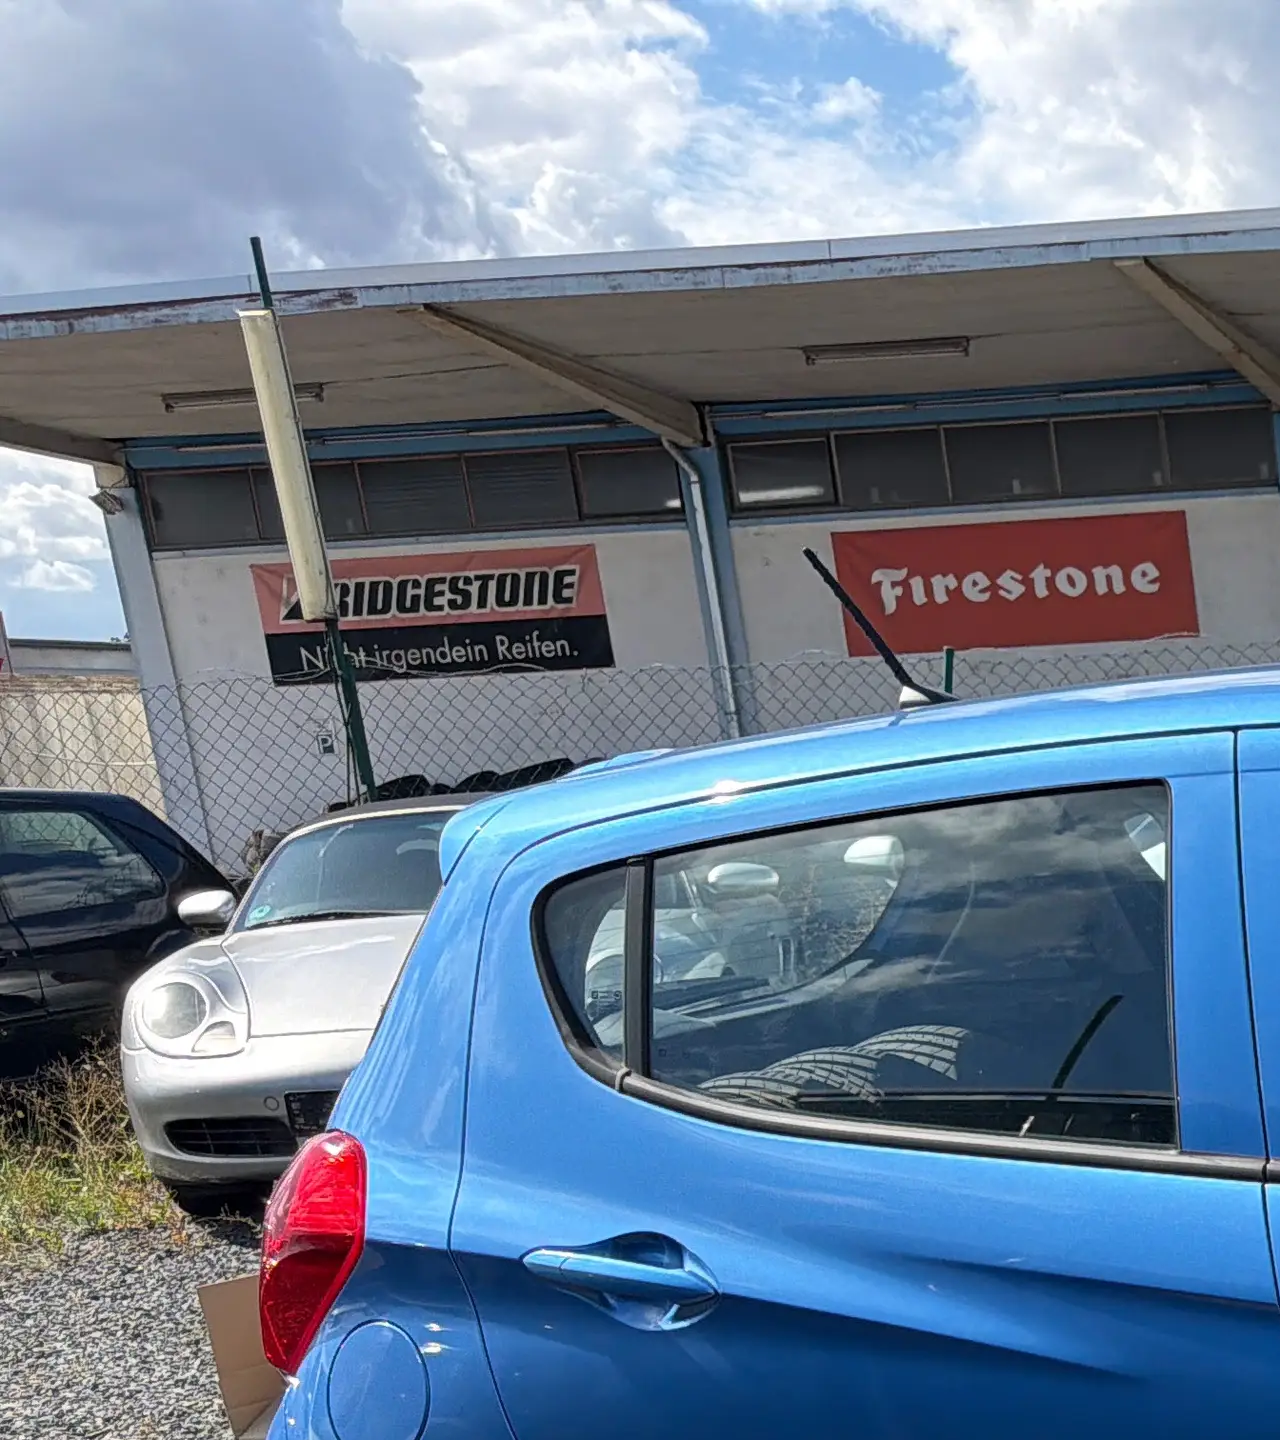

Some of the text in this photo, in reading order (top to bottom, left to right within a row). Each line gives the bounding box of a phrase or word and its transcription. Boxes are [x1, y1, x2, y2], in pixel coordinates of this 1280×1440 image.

[870, 561, 1161, 616] Firestone
[373, 636, 489, 673] irgendein
[495, 630, 579, 661] Reifen.
